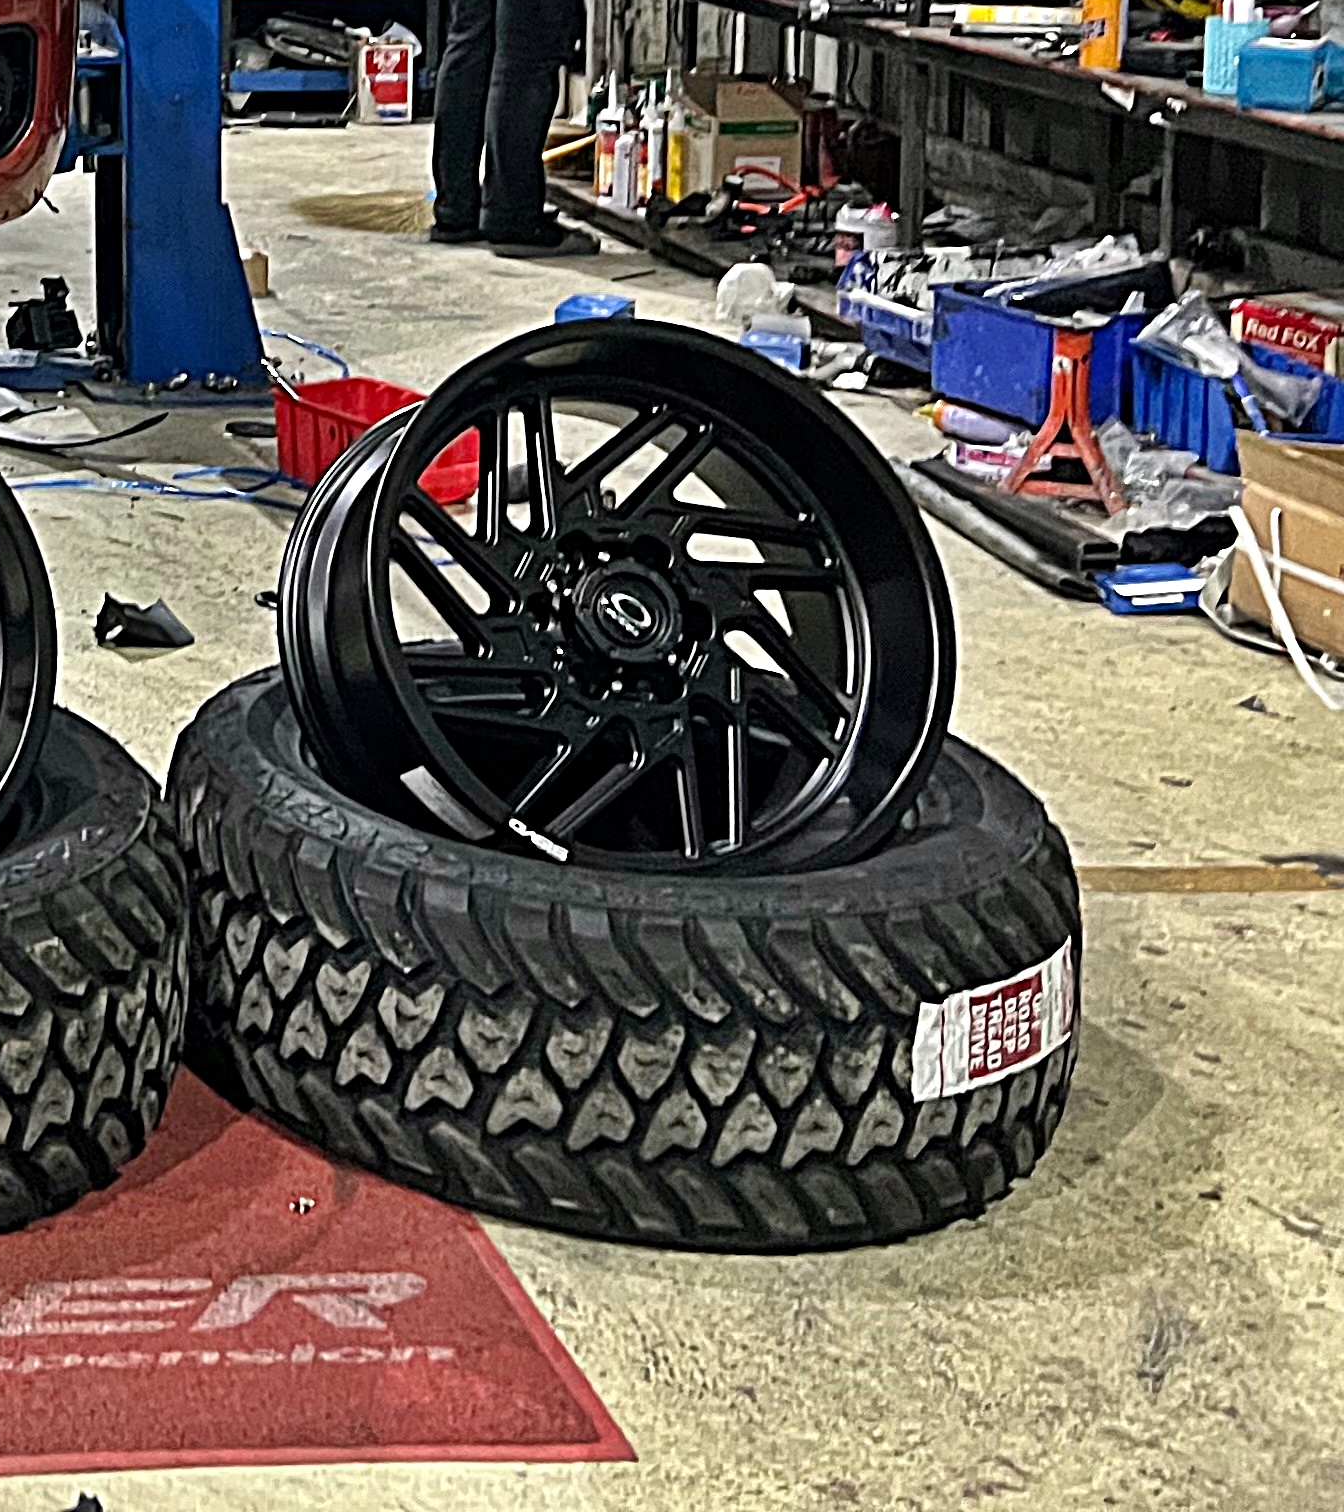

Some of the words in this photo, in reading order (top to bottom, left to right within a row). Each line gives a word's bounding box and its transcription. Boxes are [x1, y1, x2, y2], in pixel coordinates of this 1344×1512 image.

[1244, 317, 1280, 342] Red
[1280, 326, 1322, 353] FOX
[970, 1003, 988, 1071] DRIVE
[986, 992, 1003, 1071] TREAD
[1003, 996, 1018, 1054] DEEP
[1017, 988, 1033, 1052] ROAD
